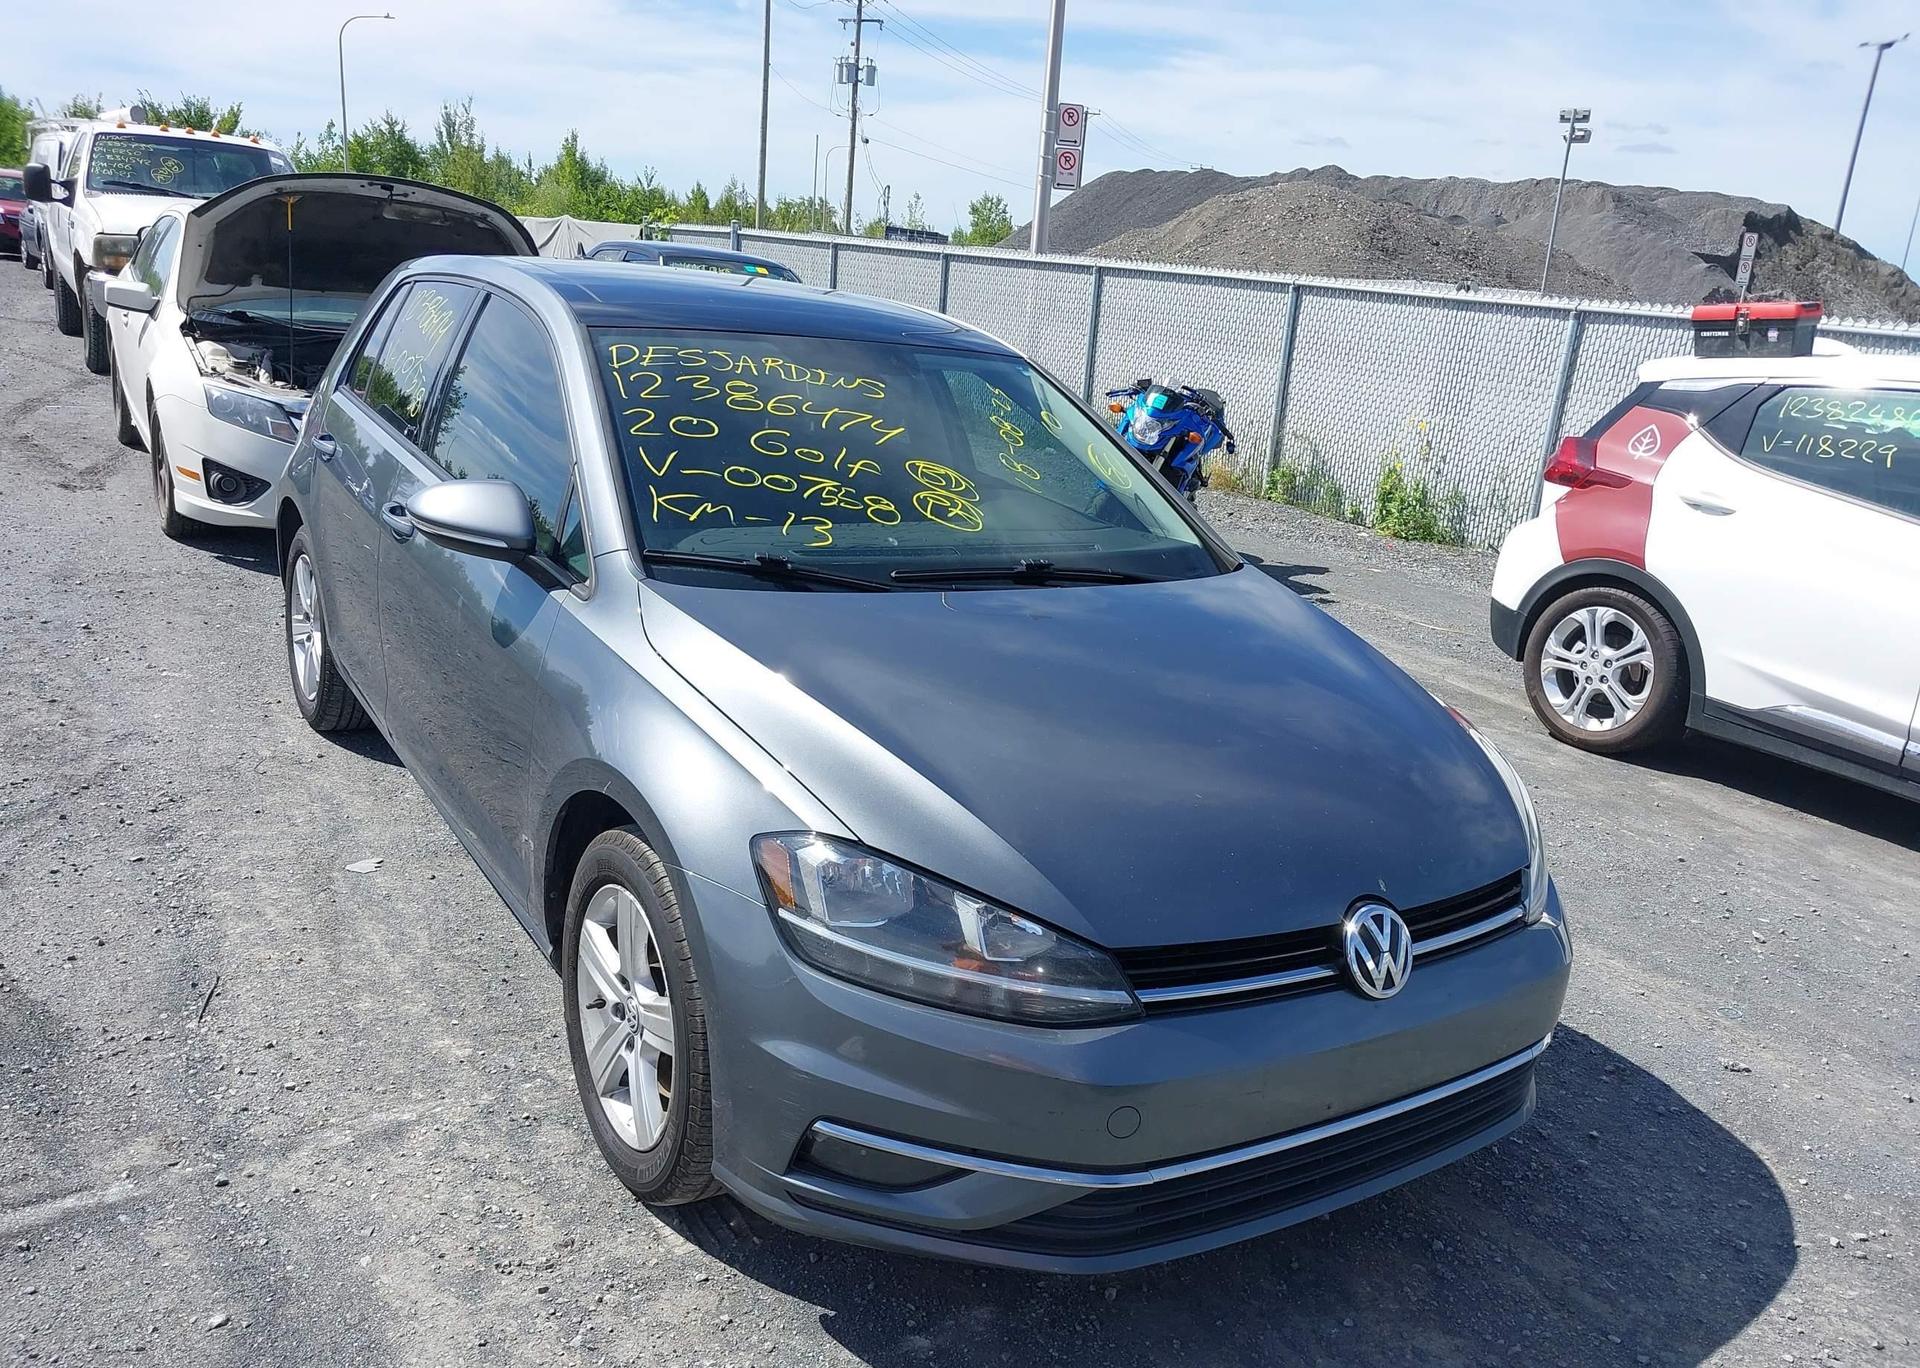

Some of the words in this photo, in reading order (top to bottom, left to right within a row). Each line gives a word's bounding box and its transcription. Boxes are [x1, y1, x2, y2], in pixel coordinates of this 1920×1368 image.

[608, 344, 886, 399] DESJARDINS
[612, 371, 905, 445] 12386474
[622, 408, 720, 438] 20
[1763, 429, 1898, 468] V-118229
